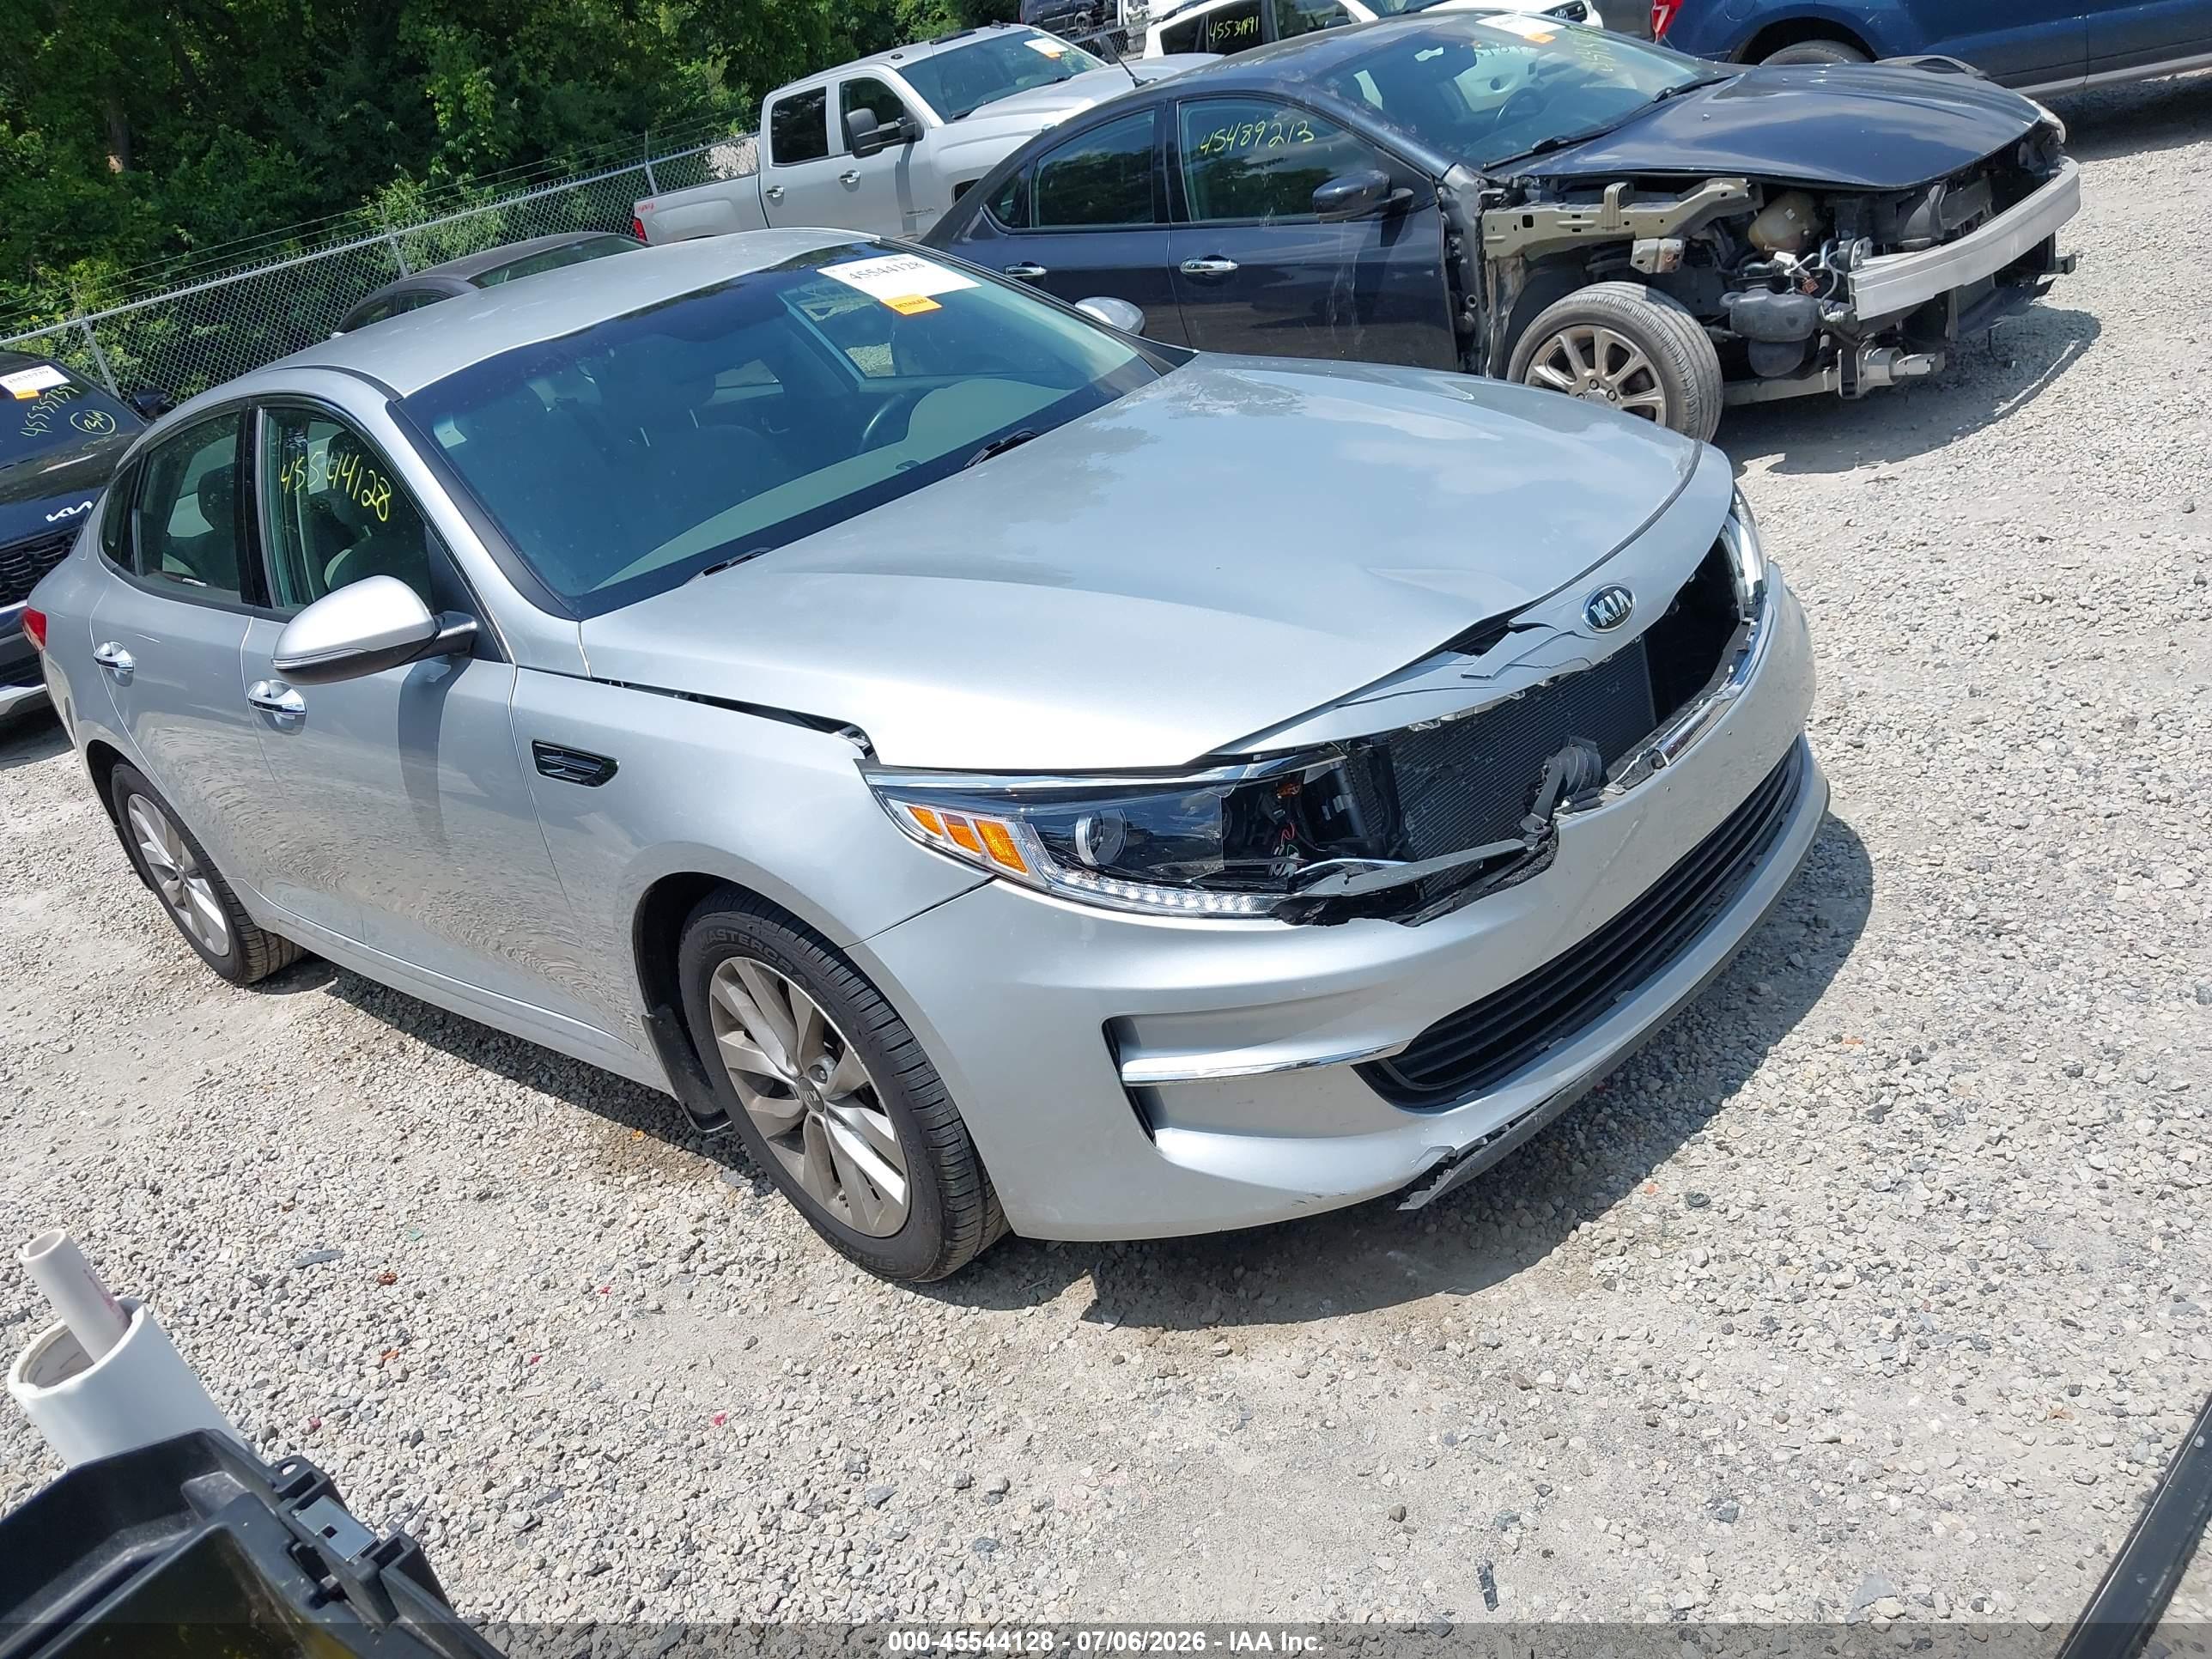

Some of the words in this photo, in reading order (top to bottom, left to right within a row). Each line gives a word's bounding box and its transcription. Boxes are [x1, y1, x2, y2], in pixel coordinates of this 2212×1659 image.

[1200, 120, 1316, 155] 45489213
[849, 260, 925, 281] 45544128
[20, 385, 81, 437] 45535739
[281, 451, 392, 522] 45544128
[1589, 589, 1632, 627] KIA
